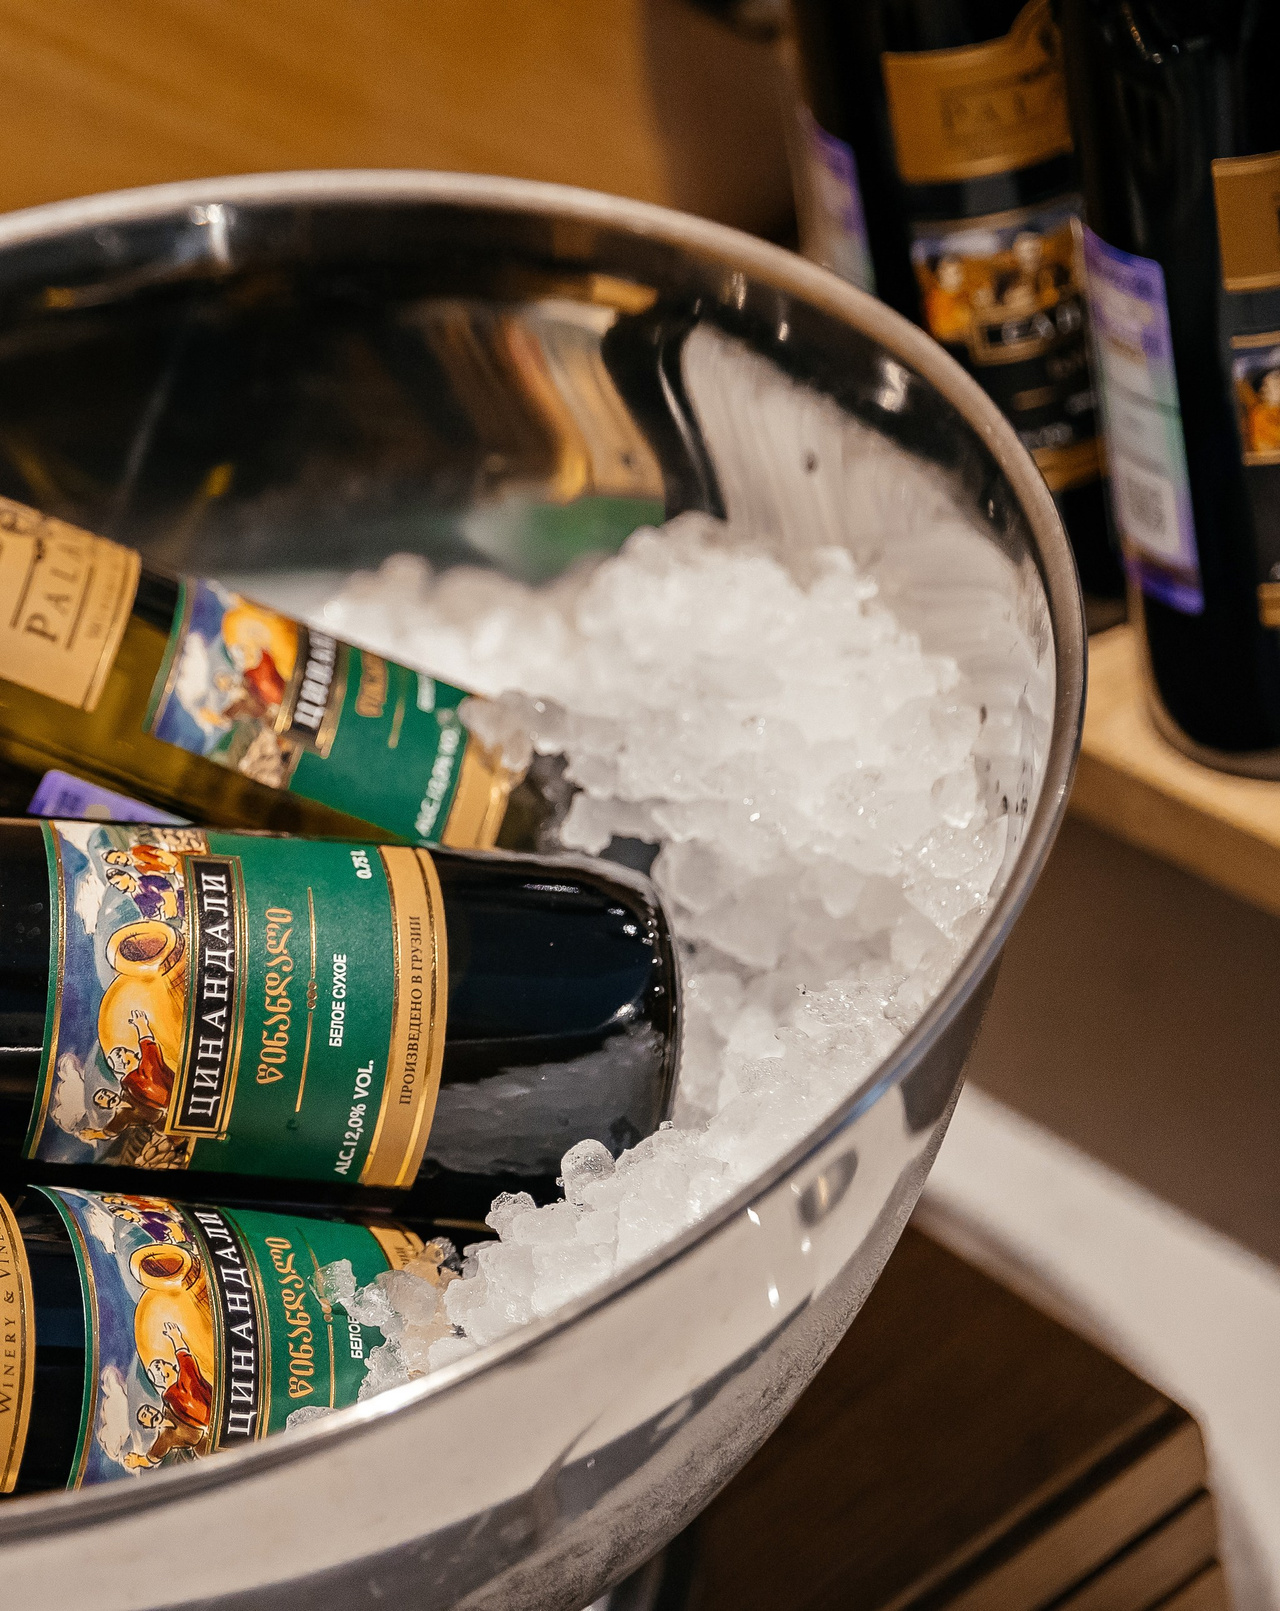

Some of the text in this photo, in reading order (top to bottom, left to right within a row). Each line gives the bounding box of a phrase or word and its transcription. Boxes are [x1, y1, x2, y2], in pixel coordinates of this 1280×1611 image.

[188, 872, 235, 1118] ЦИНАНДАЛИ
[328, 952, 347, 1048] БЕЛОЕ СУХОЕ
[398, 915, 424, 1106] ПРОИЗВЕДЕНО В ГРУЗИИ
[352, 1059, 375, 1100] VOL.
[4, 1290, 16, 1305] &
[193, 1209, 257, 1437] ЦИНАНДАЛИ
